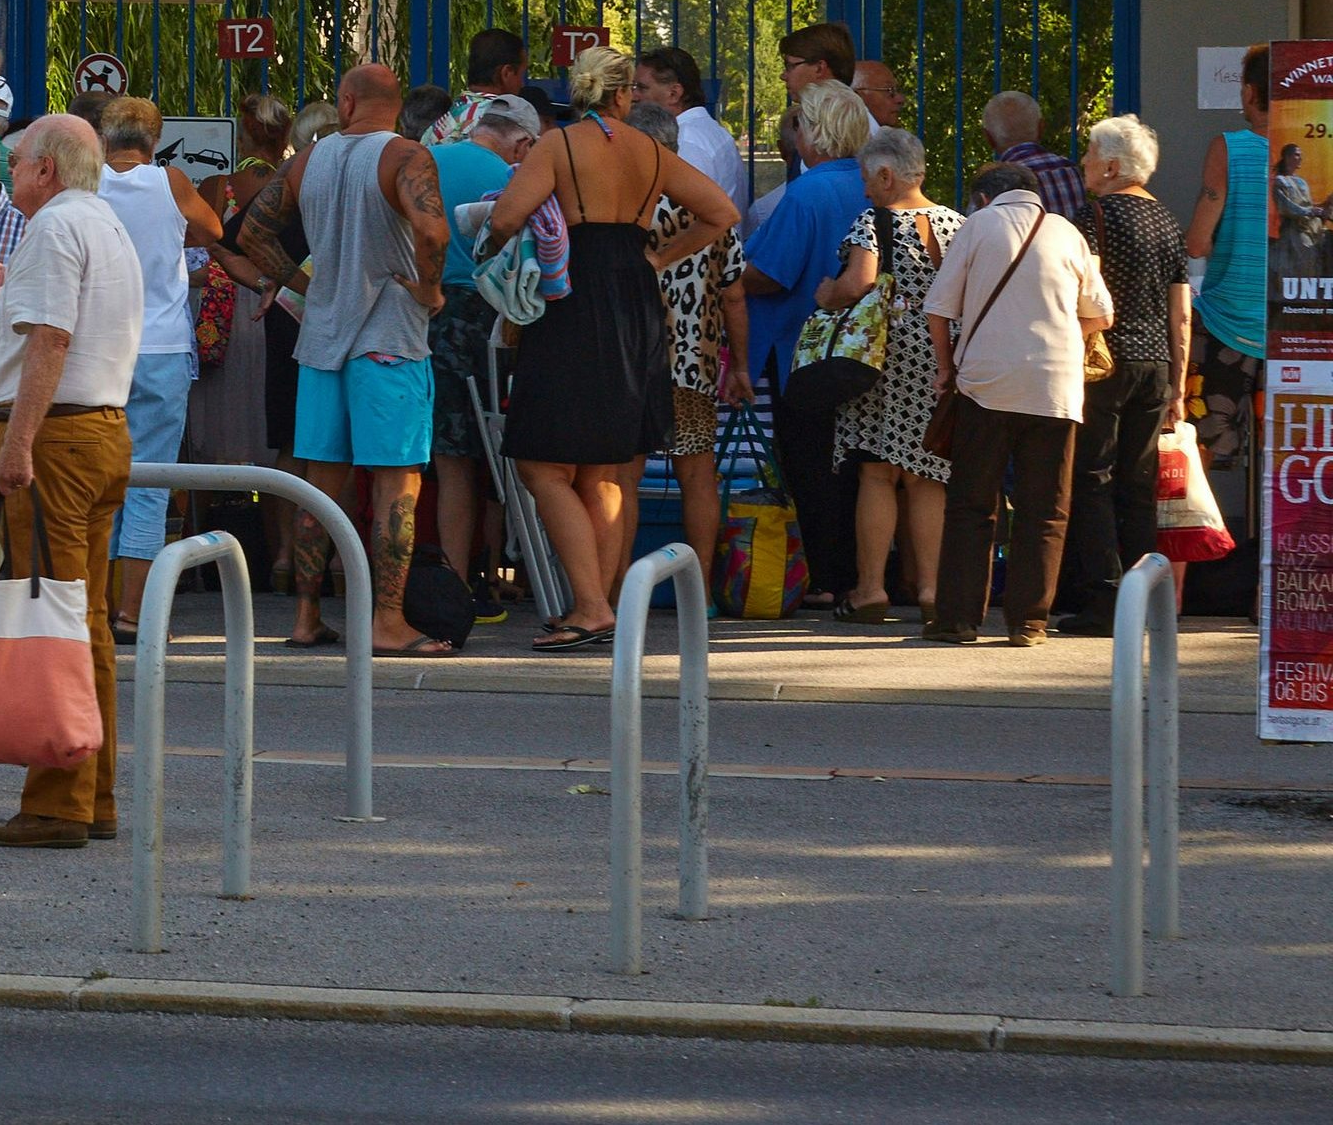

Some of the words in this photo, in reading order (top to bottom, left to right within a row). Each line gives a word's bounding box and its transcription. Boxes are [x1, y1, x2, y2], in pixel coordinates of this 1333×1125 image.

[226, 24, 265, 53] T2
[1304, 123, 1333, 139] 29.
[1282, 277, 1333, 300] UNT
[1277, 553, 1317, 571] JAZZ
[1277, 572, 1333, 592] BALKA
[1276, 661, 1333, 682] FESTIV
[1300, 682, 1328, 702] BIS
